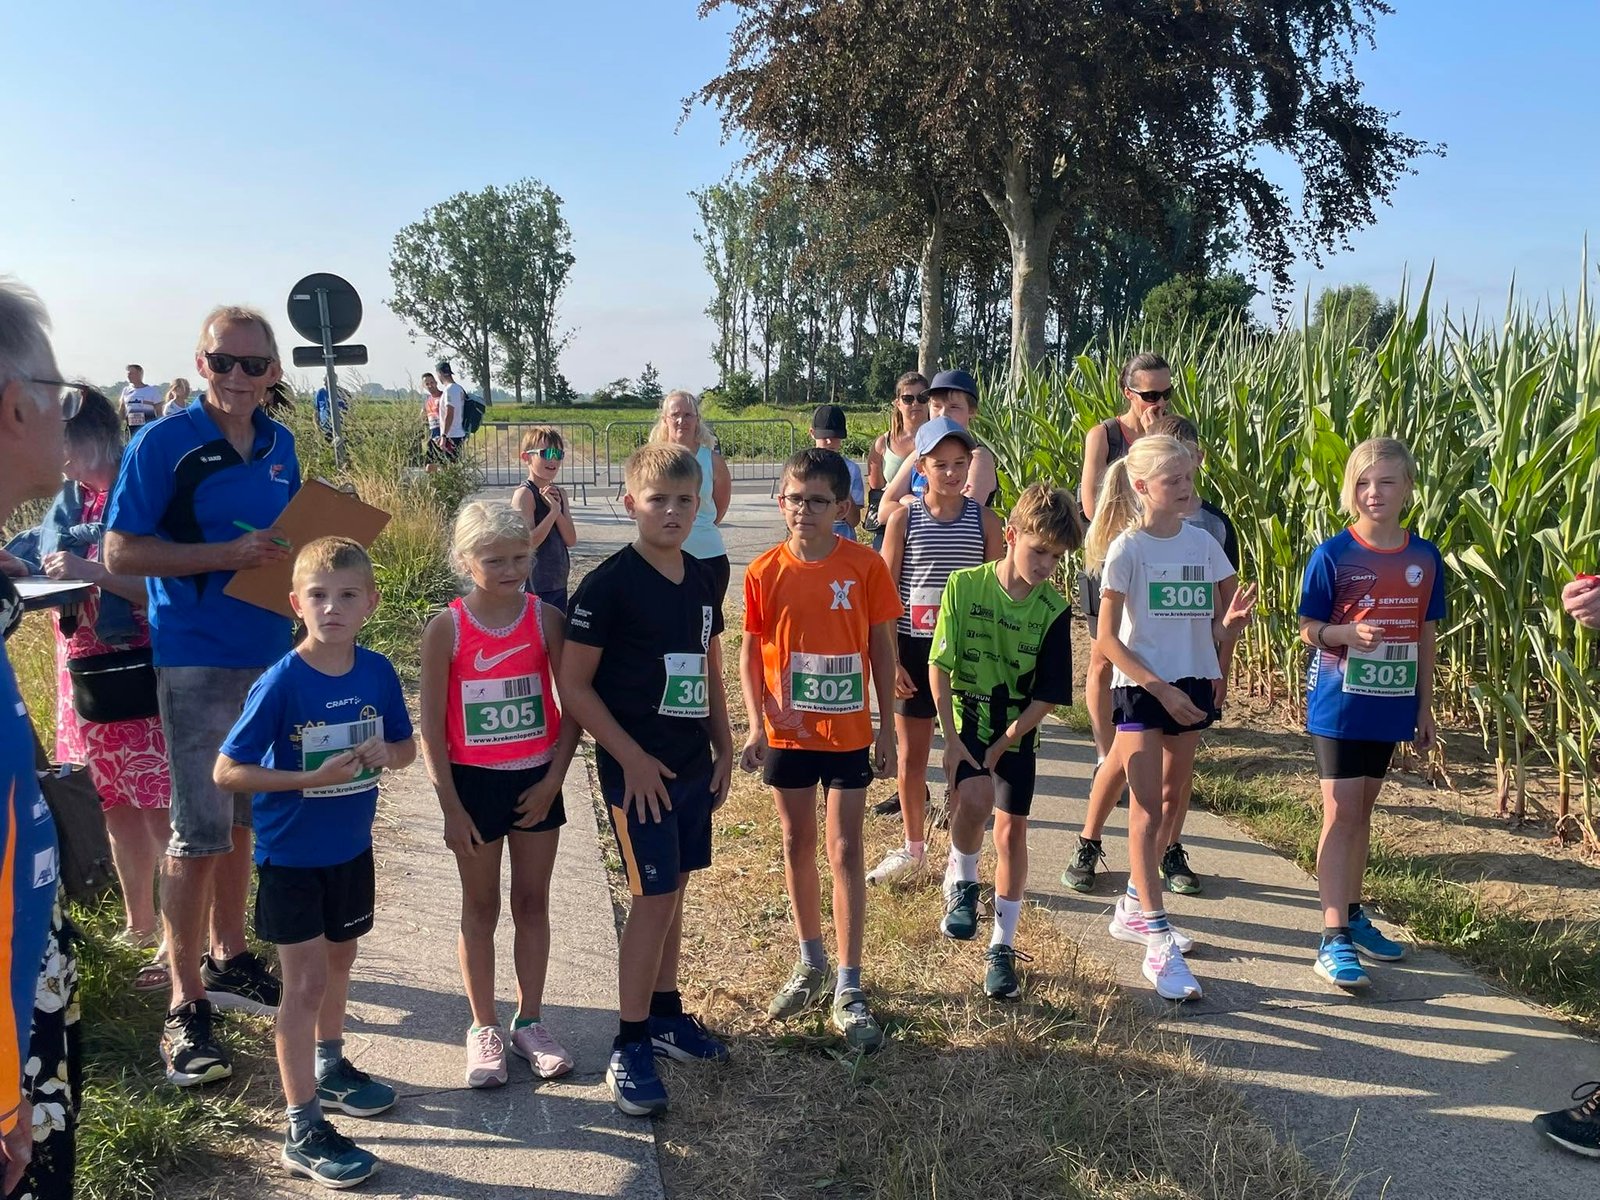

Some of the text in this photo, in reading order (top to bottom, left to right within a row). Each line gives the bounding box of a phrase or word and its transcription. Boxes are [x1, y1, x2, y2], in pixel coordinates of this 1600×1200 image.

[1161, 586, 1207, 607] 306
[1360, 663, 1408, 686] 303
[803, 677, 853, 702] 302
[326, 698, 355, 709] CRAFT
[480, 701, 536, 731] 305
